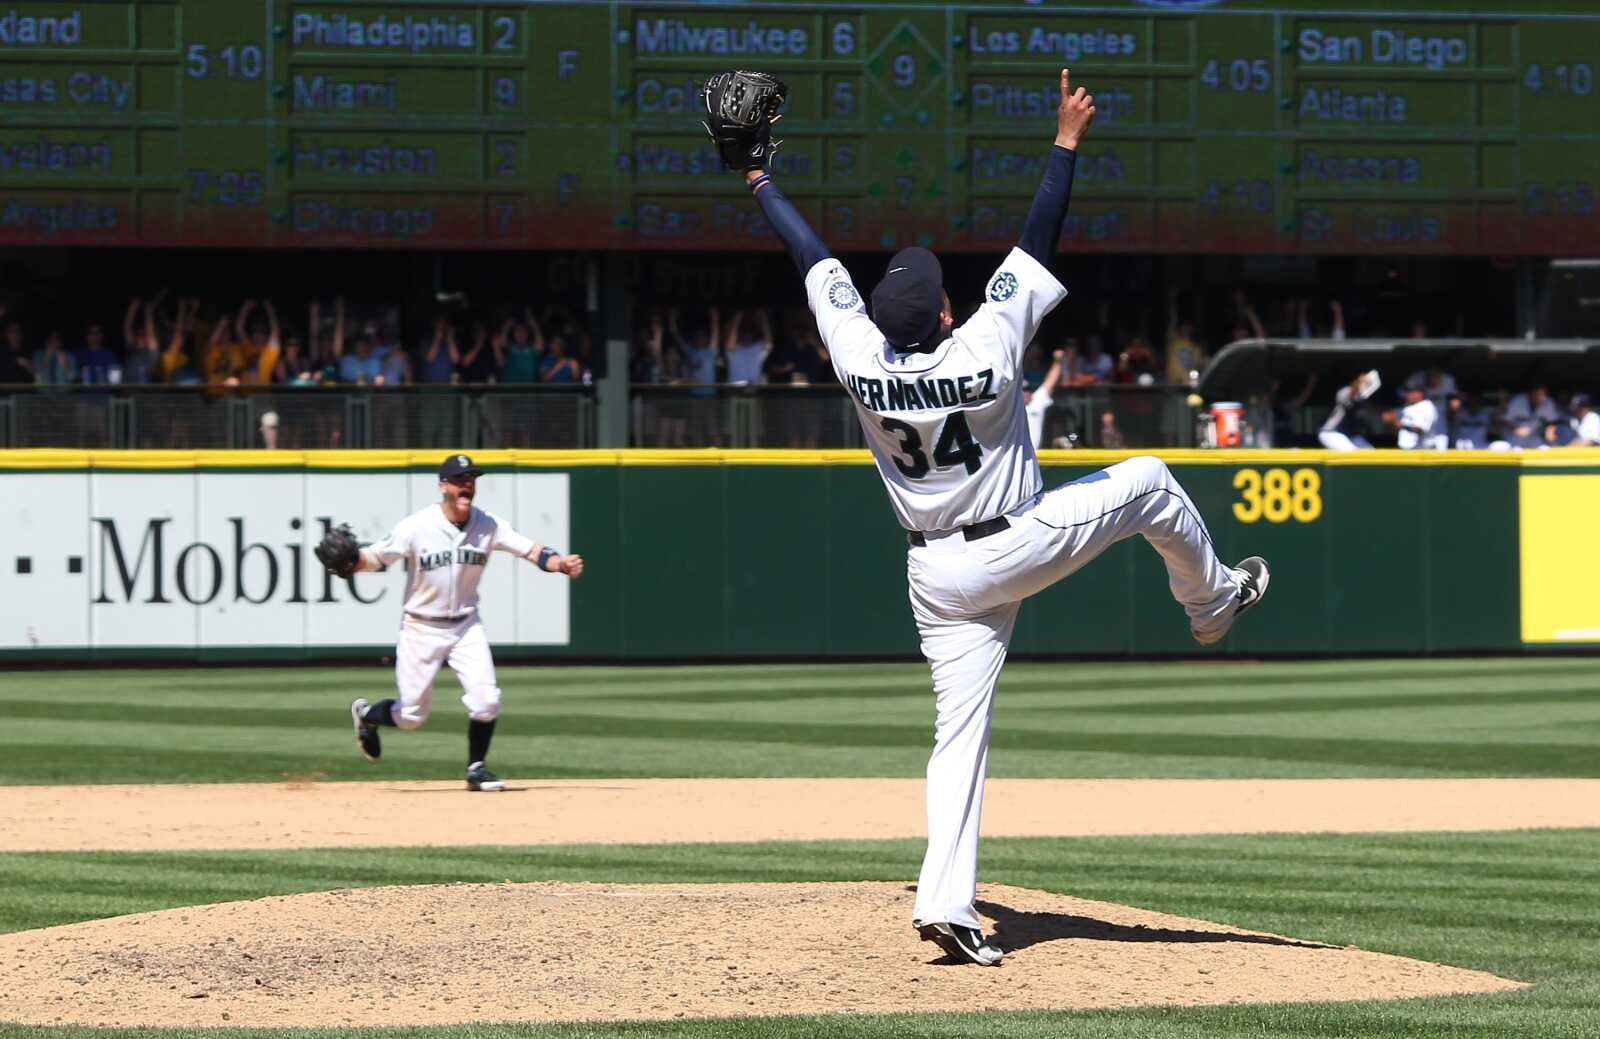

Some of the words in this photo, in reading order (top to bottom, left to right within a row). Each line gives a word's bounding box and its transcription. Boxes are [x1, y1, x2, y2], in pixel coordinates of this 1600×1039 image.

[293, 14, 475, 52] Philadelphia
[494, 16, 517, 49] 2
[635, 18, 807, 55] Milwaukee
[831, 20, 855, 56] 6
[970, 25, 1021, 55] Los
[1026, 27, 1136, 61] Angeles
[1298, 28, 1362, 62] San
[1371, 30, 1468, 71] Diego
[558, 49, 580, 81] F
[893, 54, 916, 88] 9
[67, 71, 130, 113] City
[293, 75, 396, 111] Miami
[494, 78, 517, 112] 9
[831, 82, 855, 116] 5
[1297, 87, 1408, 124] Atlanta
[293, 141, 438, 178] Houston
[847, 367, 997, 412] HERNANDEZ
[880, 410, 984, 479] 34
[1232, 468, 1322, 523] 388
